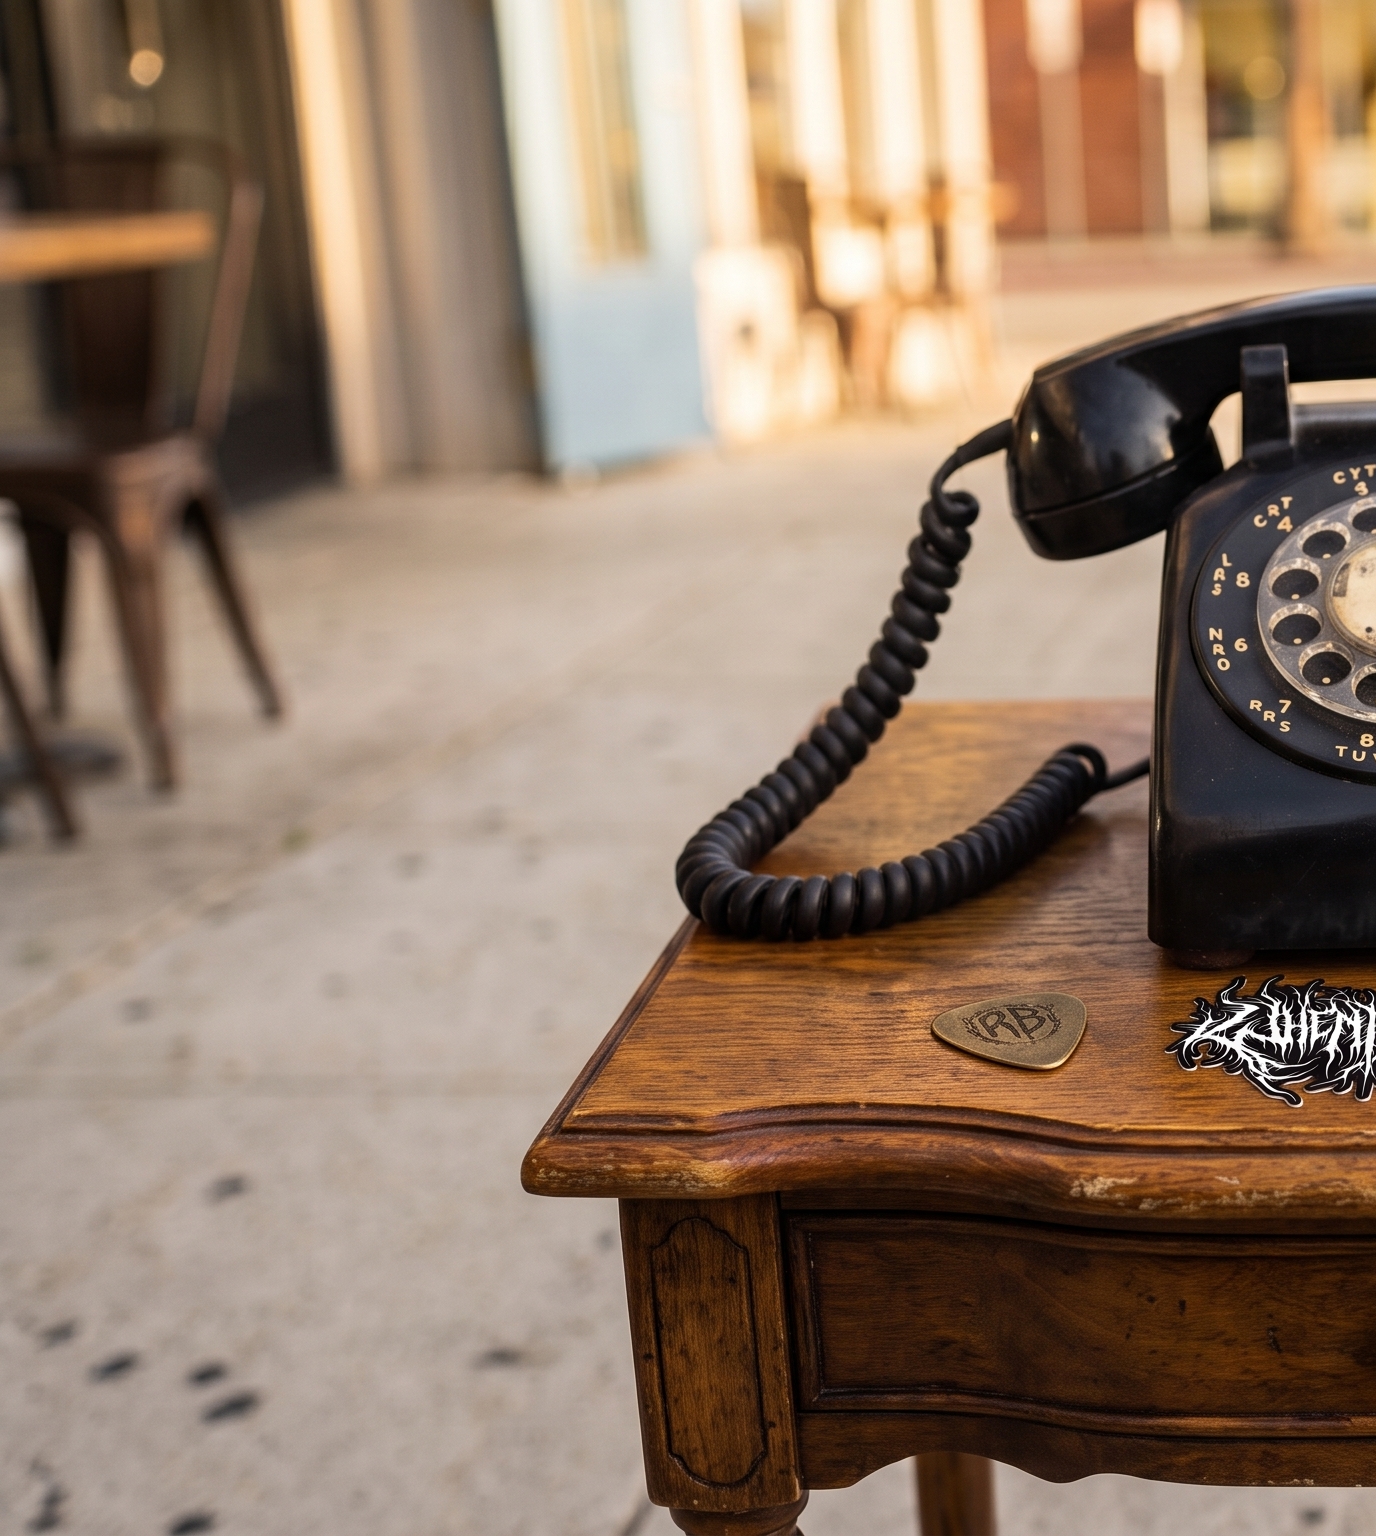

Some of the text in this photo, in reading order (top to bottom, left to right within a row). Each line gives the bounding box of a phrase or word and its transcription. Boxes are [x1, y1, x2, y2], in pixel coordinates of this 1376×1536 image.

[1253, 496, 1293, 528] CRT
[1277, 515, 1293, 532] 4
[1236, 571, 1250, 587] 8
[1234, 638, 1248, 652] 6
[1278, 699, 1292, 714] 7
[1249, 699, 1291, 732] RRS
[1359, 733, 1374, 747] 8
[977, 1007, 1046, 1039] RB
